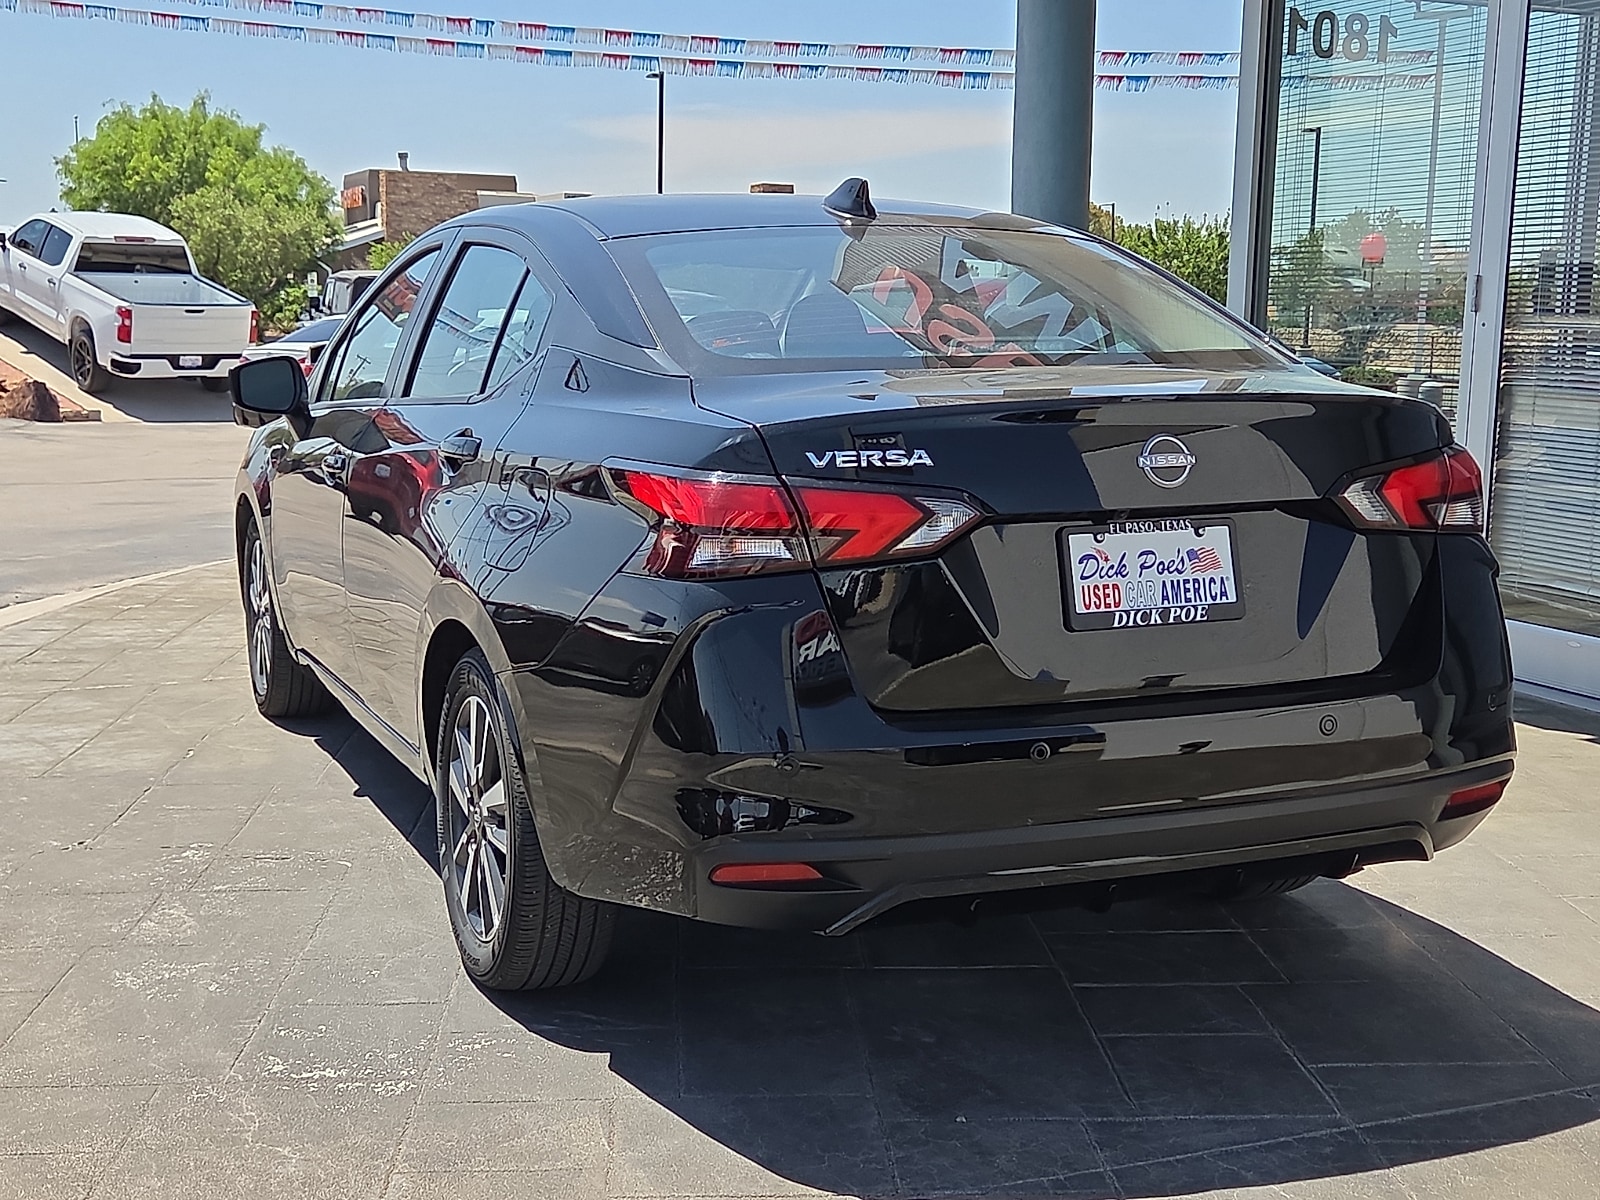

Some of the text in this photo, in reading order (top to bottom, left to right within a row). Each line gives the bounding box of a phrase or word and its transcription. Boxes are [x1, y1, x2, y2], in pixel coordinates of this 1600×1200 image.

[805, 449, 935, 468] VERSA
[1140, 454, 1196, 466] NISSAN
[1109, 524, 1121, 534] EL
[1160, 519, 1192, 531] TEXAS
[1078, 547, 1187, 580] Dick Poe's
[1081, 576, 1230, 611] USED CAR AMERICA
[1112, 605, 1209, 628] DICK POE
